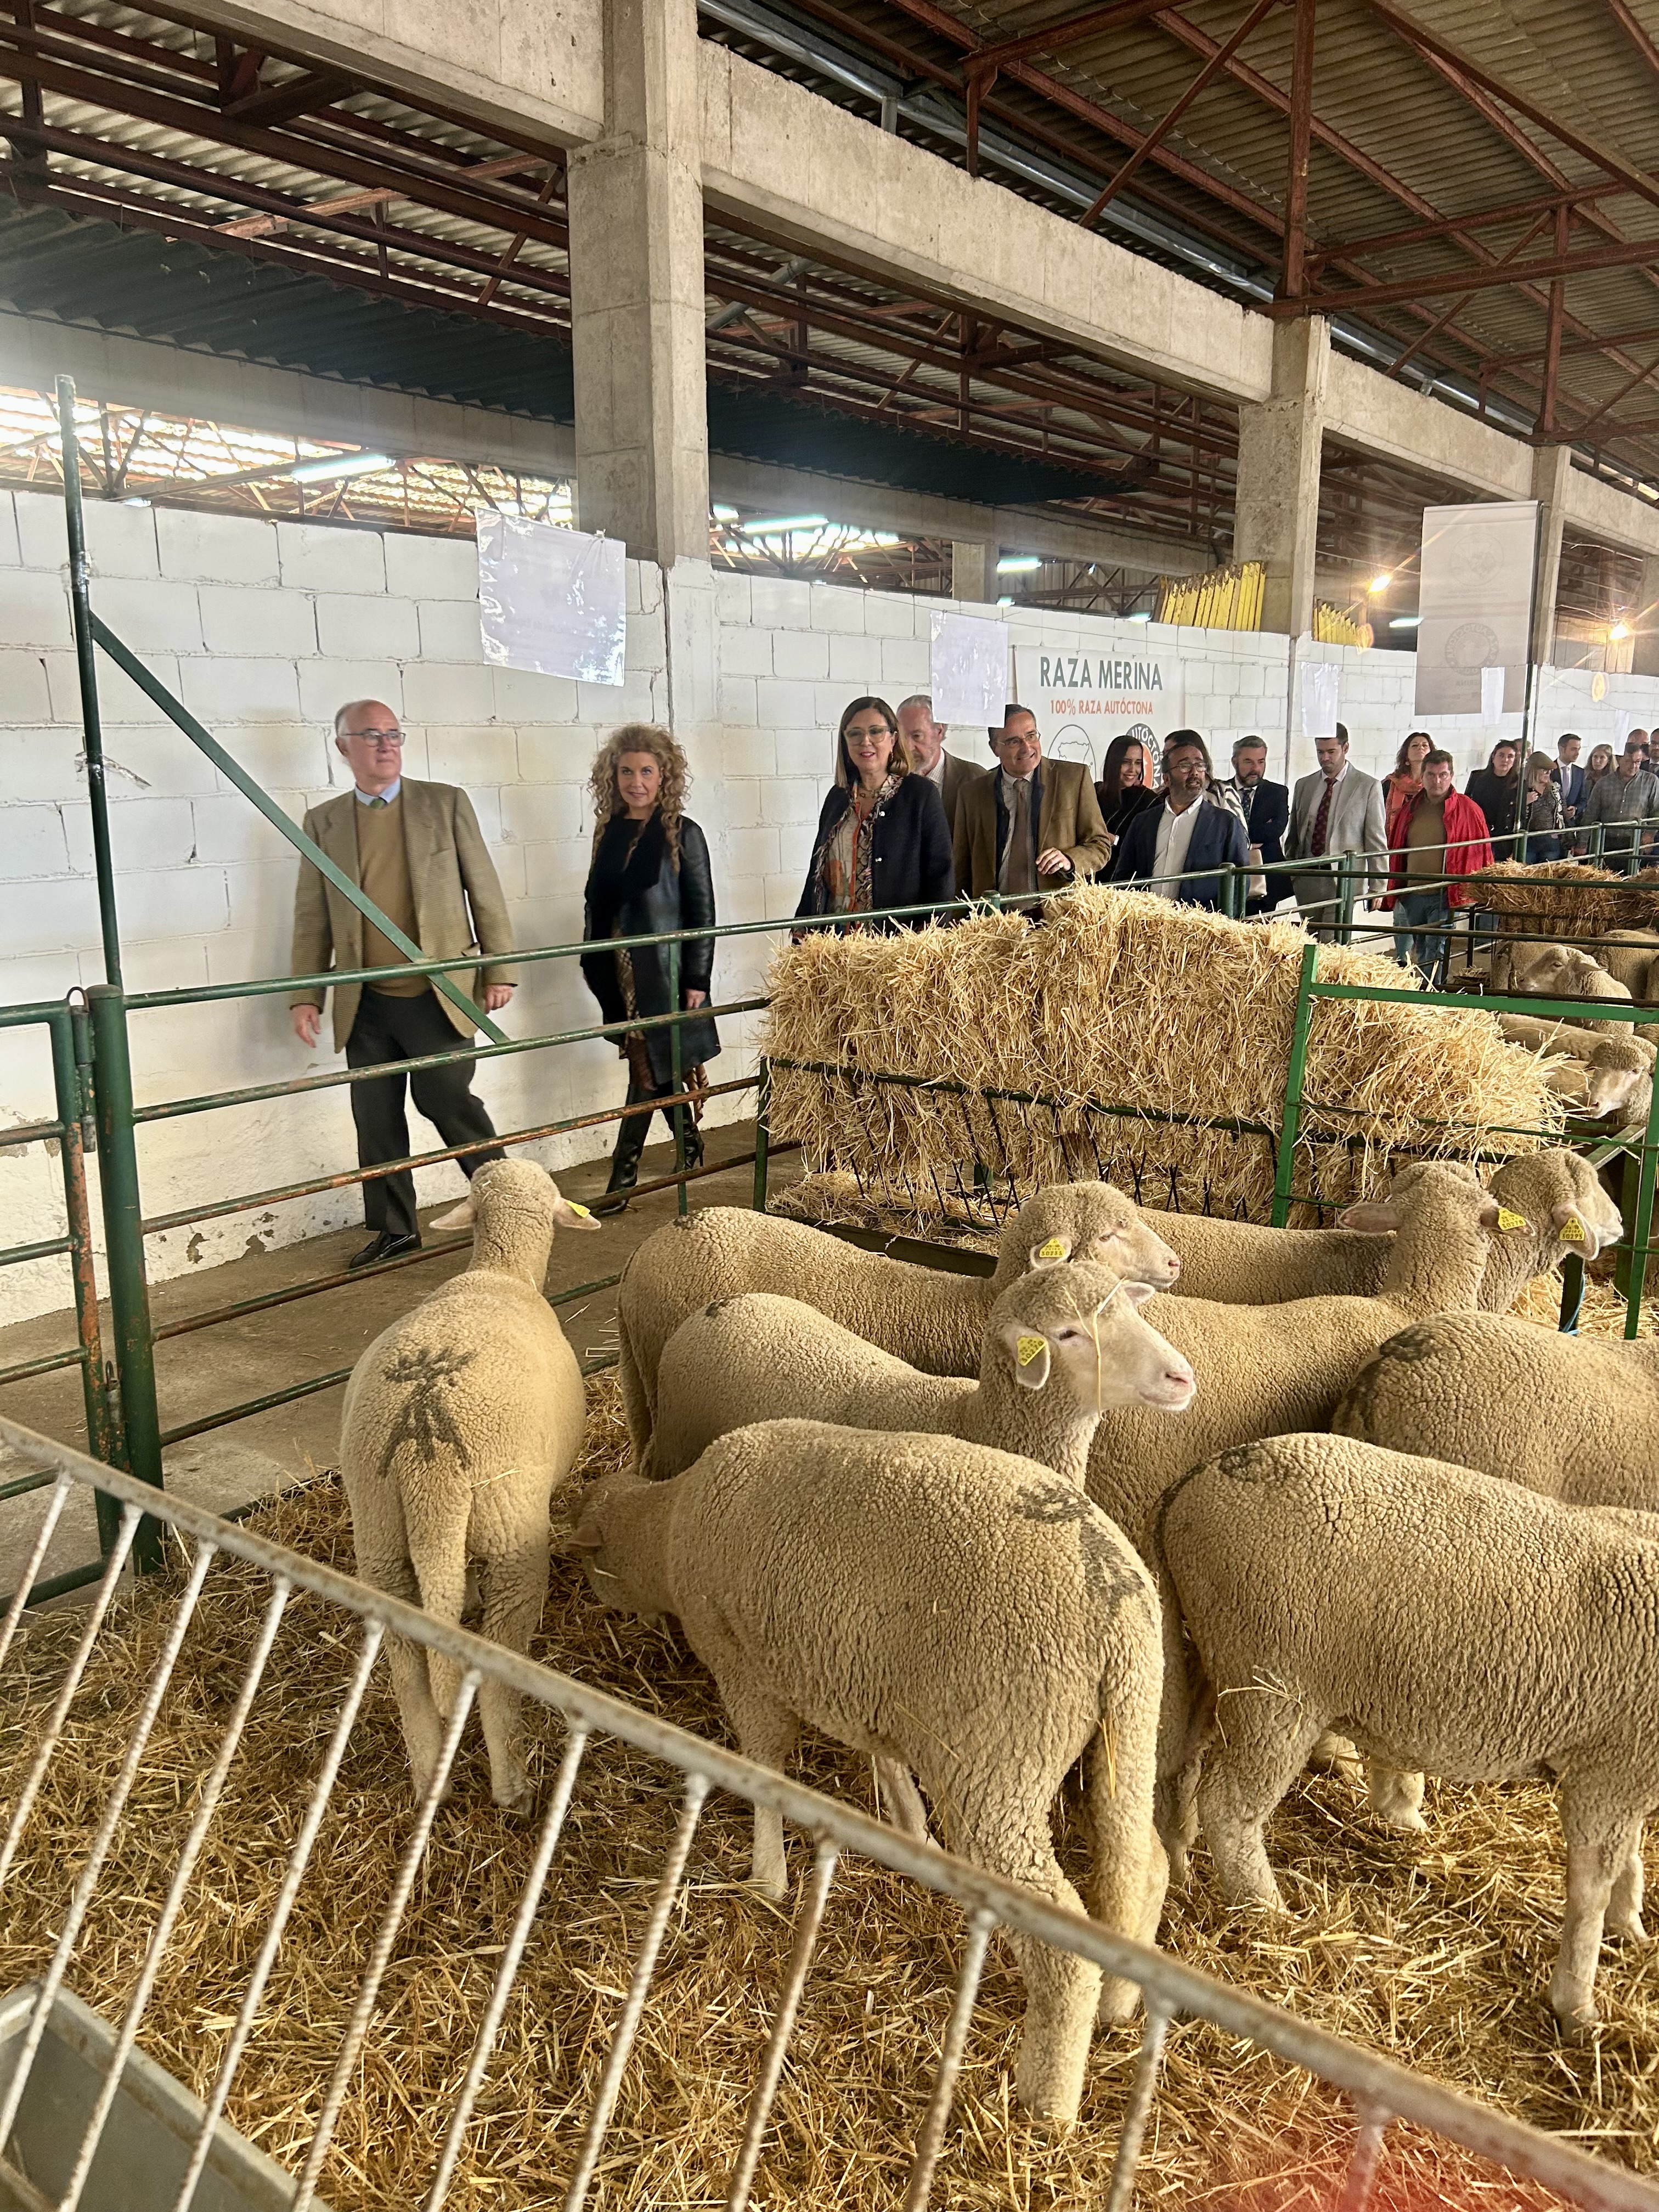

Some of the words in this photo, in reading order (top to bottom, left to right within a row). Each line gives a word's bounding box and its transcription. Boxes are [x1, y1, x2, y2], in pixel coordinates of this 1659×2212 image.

[1040, 656, 1092, 688] RAZA
[1098, 659, 1163, 691] MERINA
[1051, 698, 1076, 715] 100%
[1079, 699, 1102, 714] RAZA
[1104, 697, 1153, 715] AUTÓCTONA
[1128, 726, 1160, 789] UTÓCTONA
